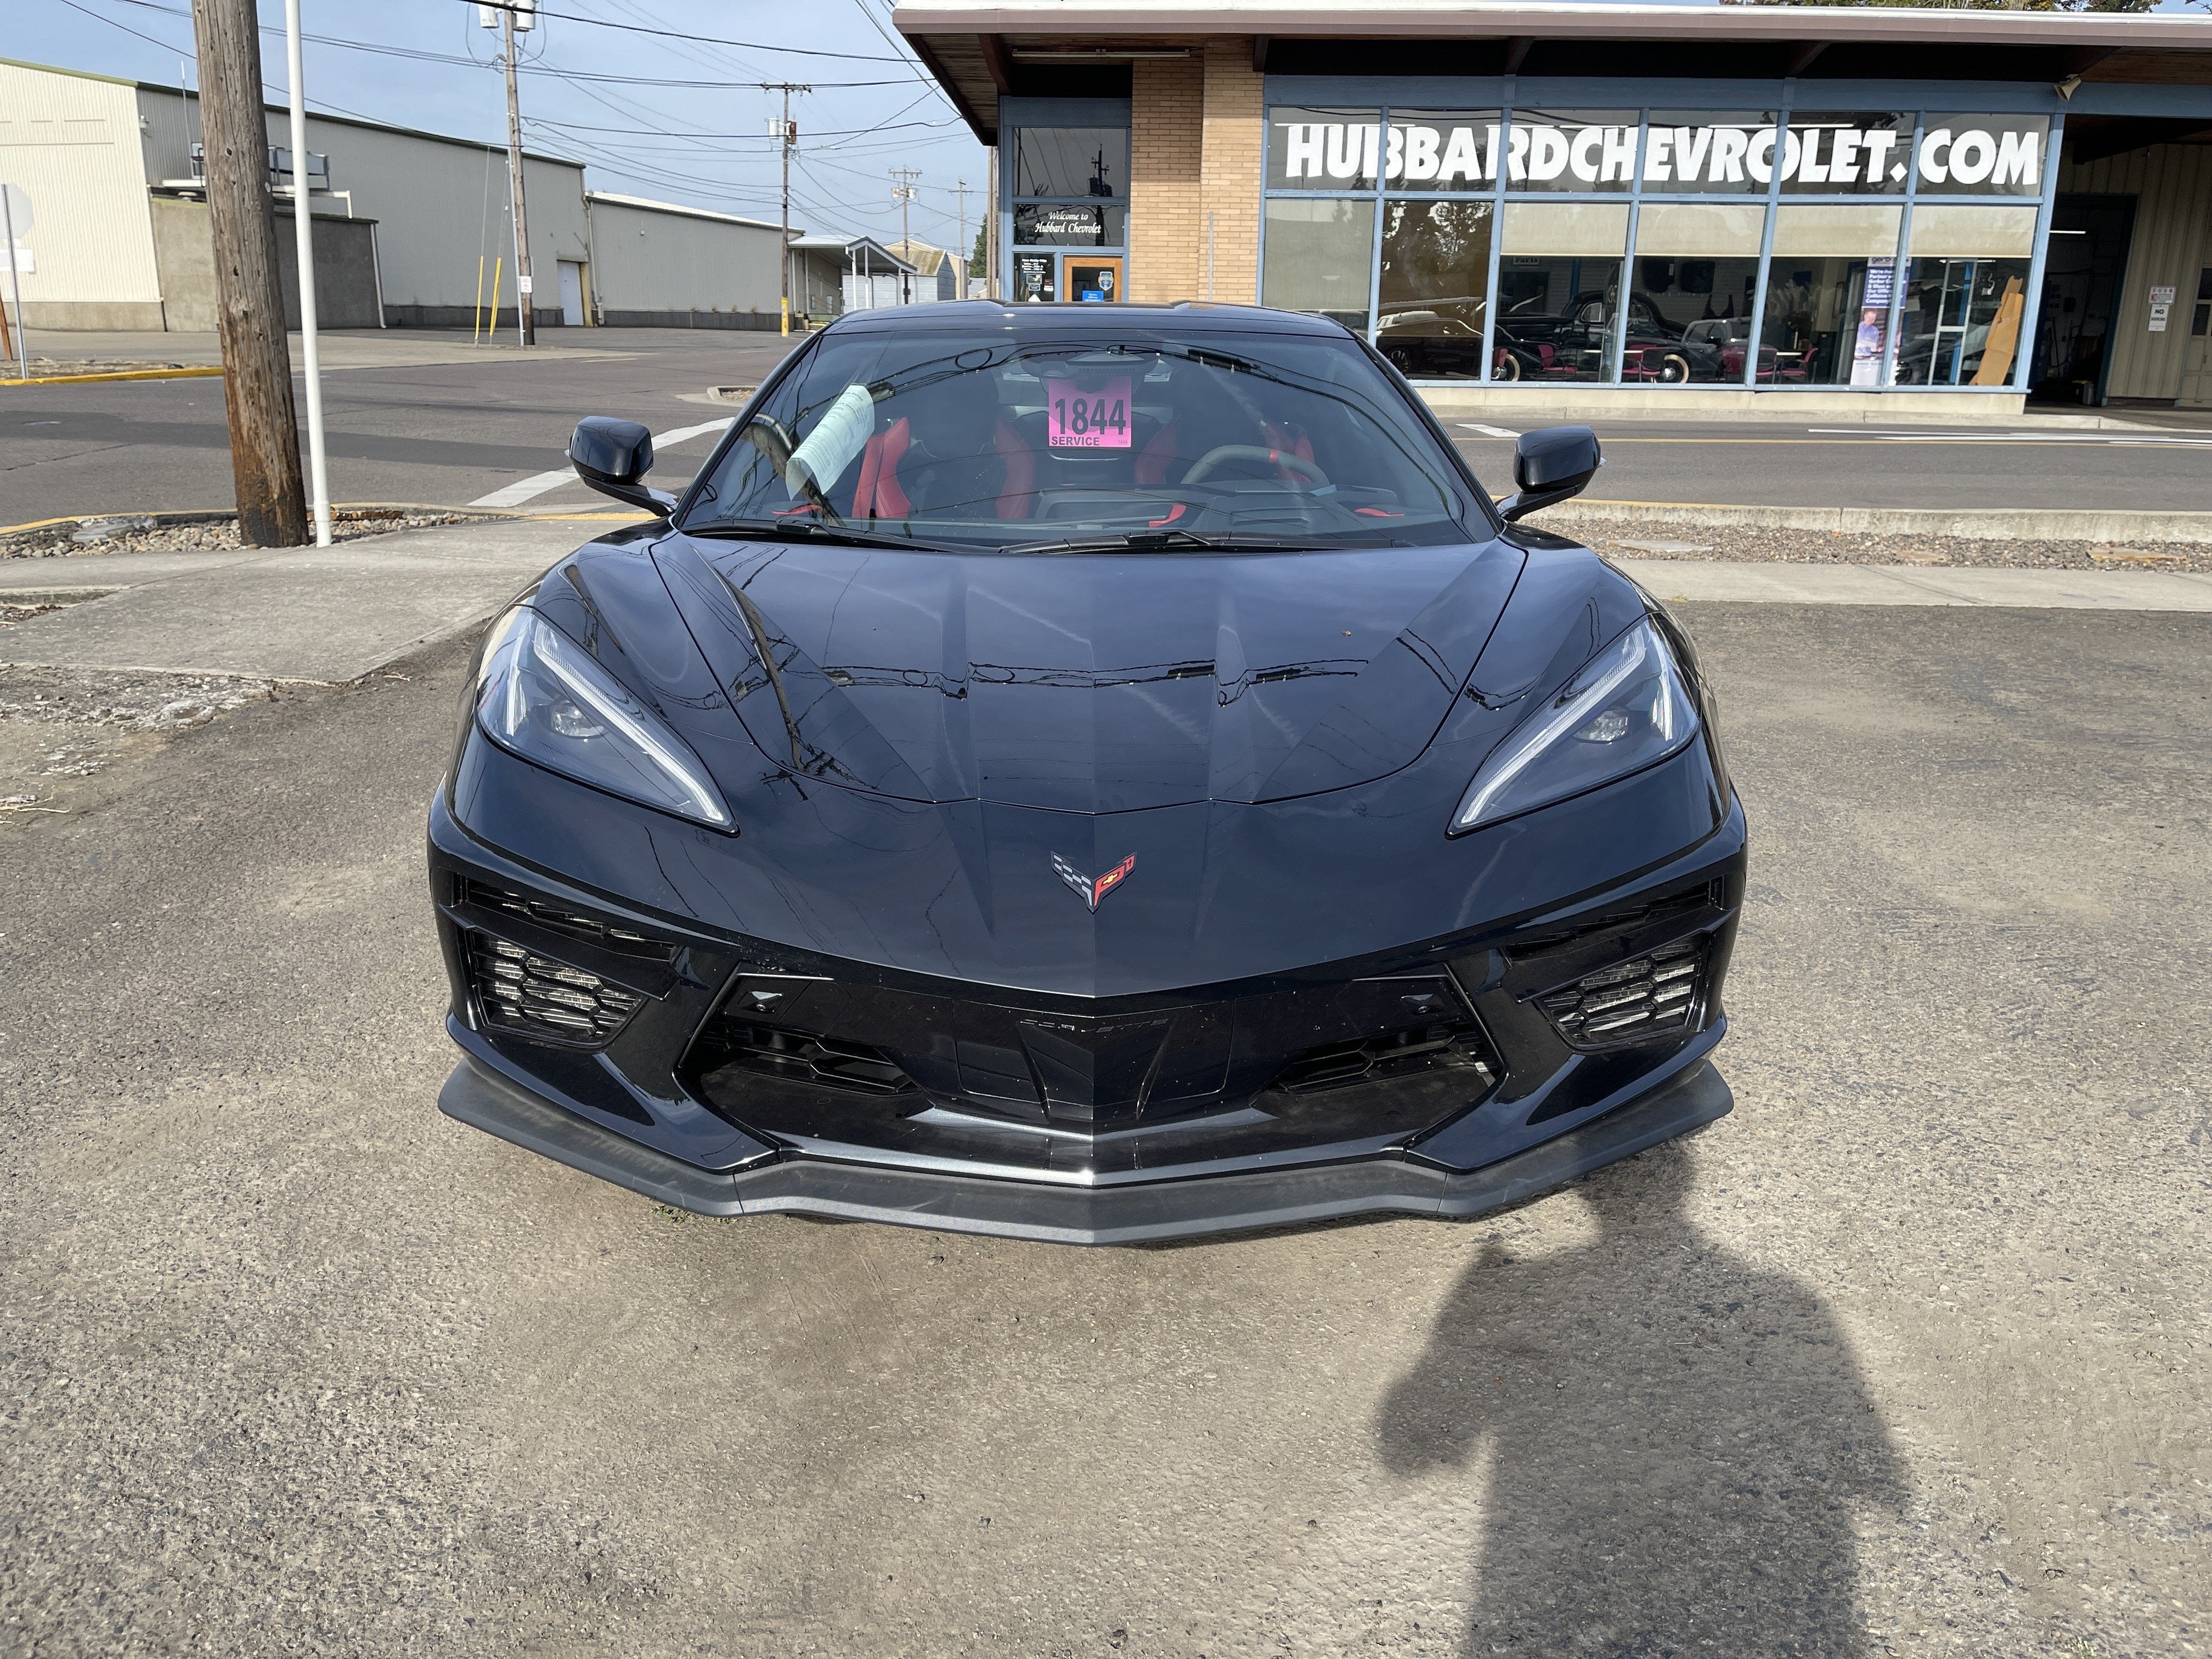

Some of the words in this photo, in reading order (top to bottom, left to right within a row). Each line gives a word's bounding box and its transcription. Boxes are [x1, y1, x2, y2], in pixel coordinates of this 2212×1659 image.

[1286, 125, 2039, 185] HUBBARDCHEVROLET.COM
[1048, 211, 1079, 220] Welcome
[1034, 221, 1067, 233] Hubbard
[1068, 222, 1102, 234] Chevrolet
[1055, 398, 1126, 435] 1844
[1051, 436, 1099, 445] SERVICE
